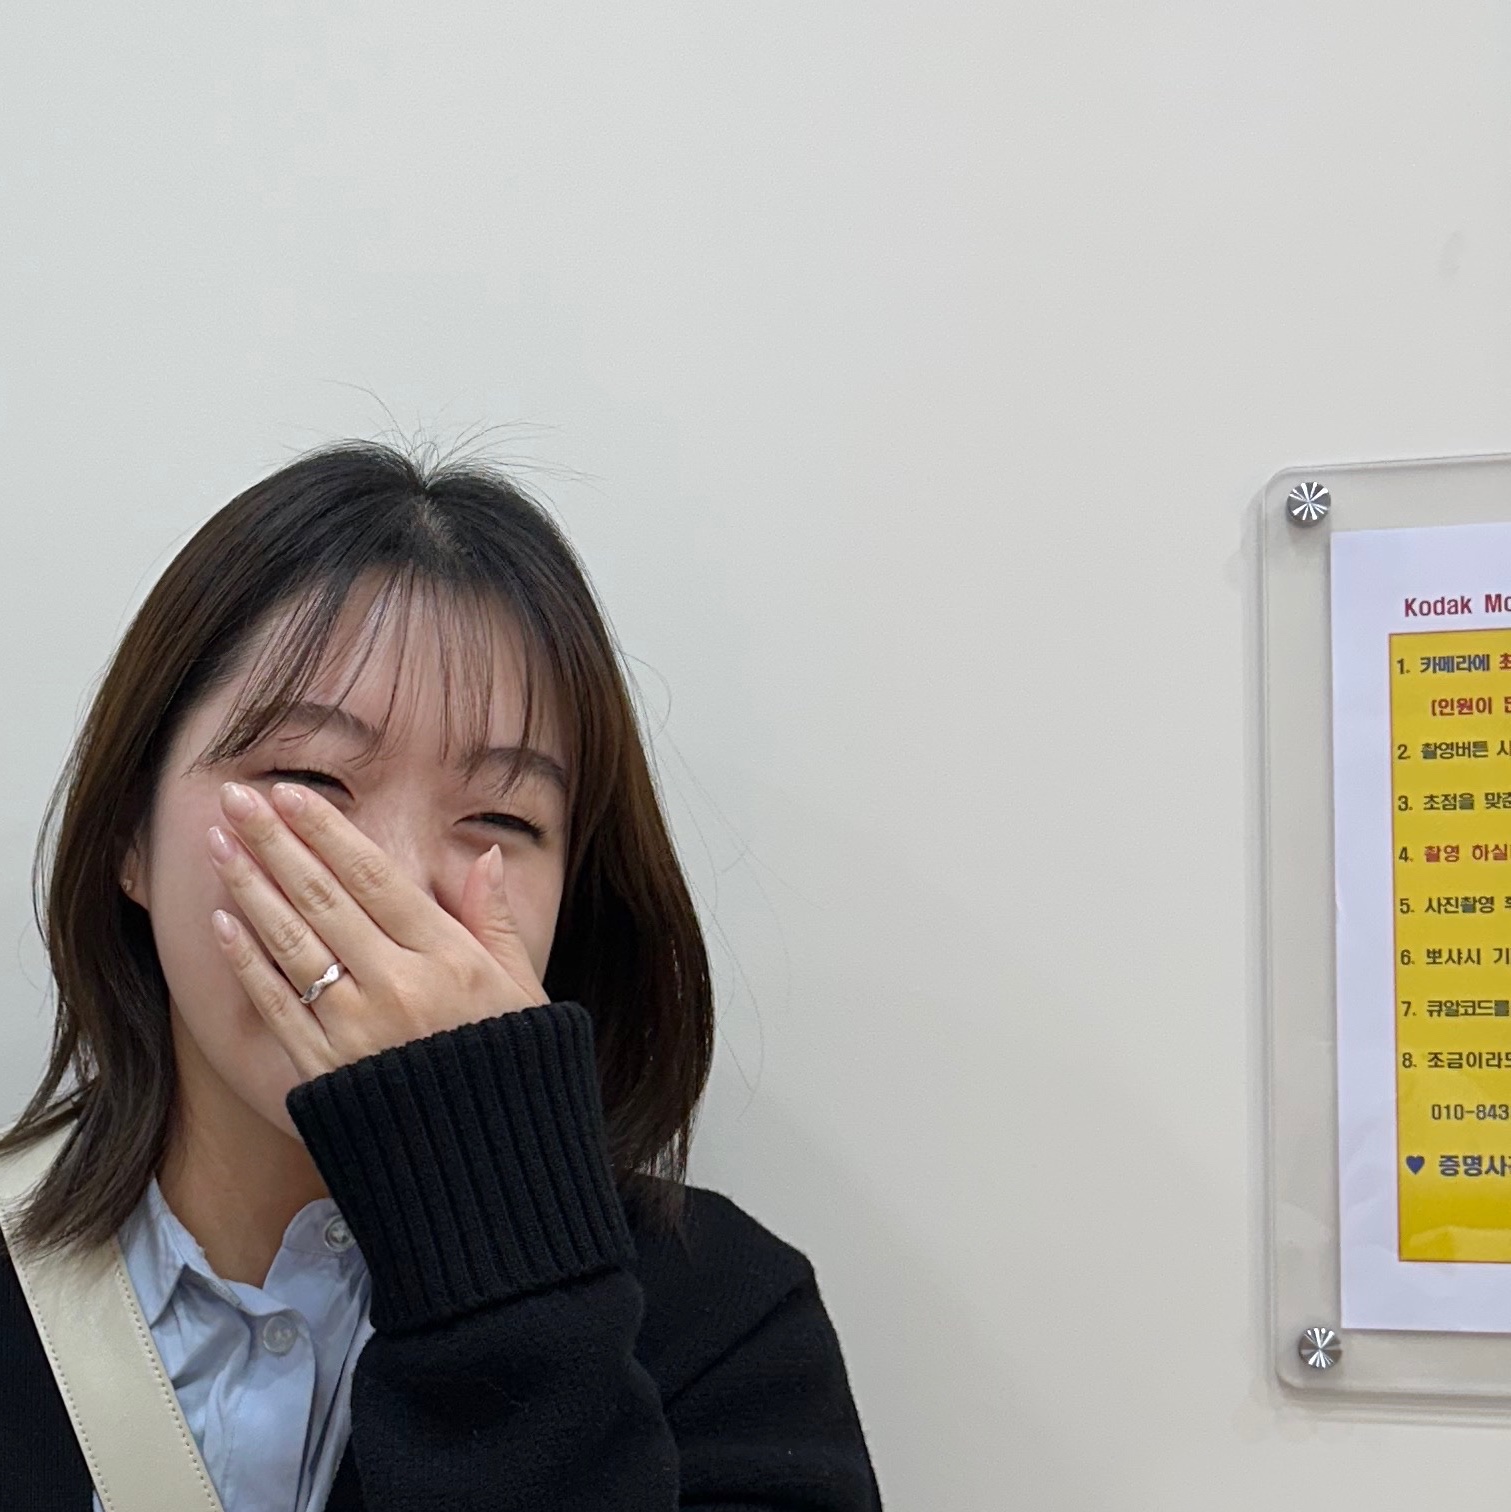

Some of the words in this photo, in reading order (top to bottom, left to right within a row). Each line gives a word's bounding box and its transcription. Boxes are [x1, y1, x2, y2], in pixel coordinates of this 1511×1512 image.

[1404, 595, 1473, 618] Kodak
[1396, 657, 1411, 675] 1.
[1419, 653, 1491, 674] 카메라에
[1397, 743, 1411, 760] 2.
[1421, 740, 1489, 760] 촬영버튼
[1397, 794, 1413, 812] 3.
[1423, 792, 1475, 811] 초점을
[1398, 845, 1414, 863] 4.
[1424, 844, 1460, 863] 촬영
[1471, 843, 1511, 862] 하실
[1399, 897, 1416, 915] 5.
[1424, 895, 1495, 915] 사진촬영
[1400, 948, 1416, 966] 6.
[1425, 947, 1481, 966] 뽀샤시
[1401, 1000, 1418, 1017] 7.
[1426, 999, 1510, 1018] 큐알코드를
[1402, 1051, 1418, 1069] 8.
[1431, 1103, 1510, 1121] 010-843
[1438, 1154, 1511, 1178] 증명사
